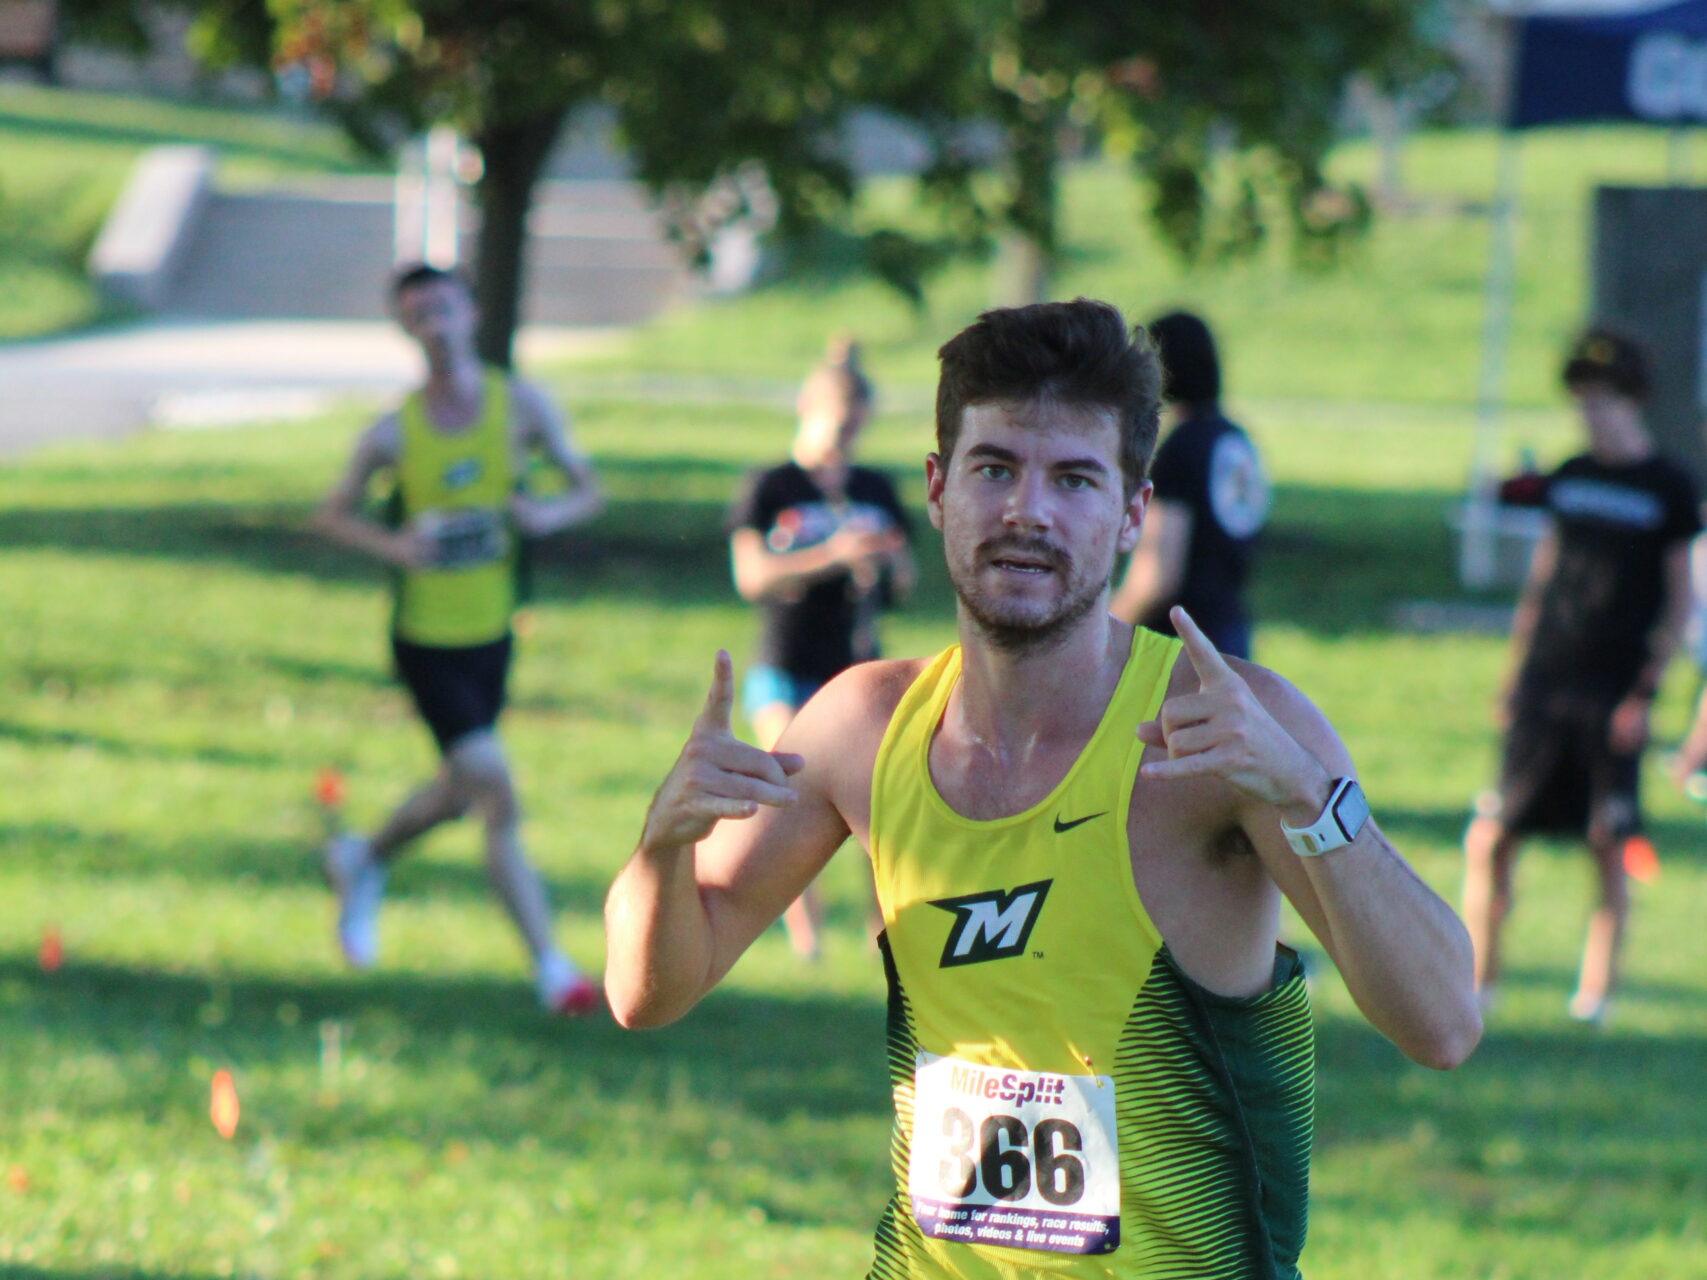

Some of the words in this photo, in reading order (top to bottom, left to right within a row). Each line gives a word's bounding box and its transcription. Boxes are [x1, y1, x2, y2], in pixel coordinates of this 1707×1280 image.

[950, 1064, 1065, 1107] MileSplit
[938, 1107, 1085, 1206] 366
[934, 1222, 973, 1238] photos,
[977, 1226, 1012, 1240] videos
[1014, 1229, 1024, 1241] &
[1026, 1230, 1046, 1243] live
[1048, 1234, 1085, 1247] events
[938, 1206, 968, 1220] home
[971, 1209, 987, 1221] for
[989, 1212, 1039, 1229] rankings,
[1041, 1217, 1067, 1229] race
[1069, 1218, 1109, 1235] results,
